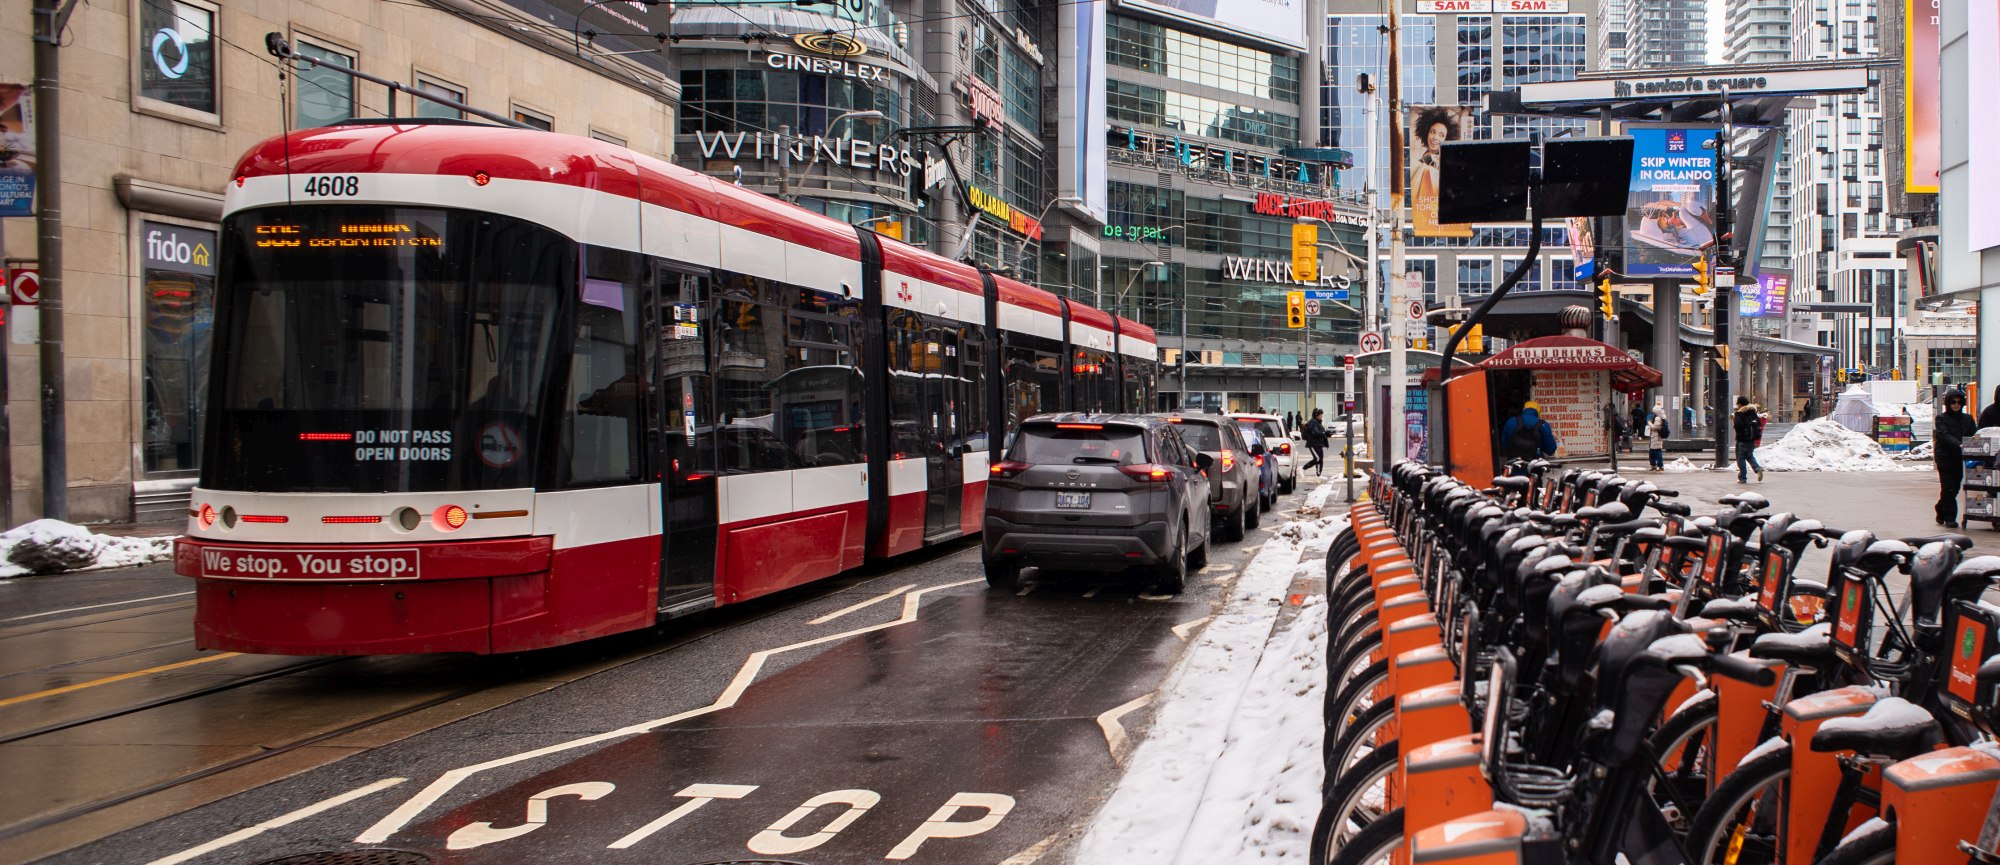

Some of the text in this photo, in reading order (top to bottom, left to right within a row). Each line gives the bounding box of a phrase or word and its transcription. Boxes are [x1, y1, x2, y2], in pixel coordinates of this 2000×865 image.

[1435, 1, 1470, 10] SAM
[1511, 1, 1546, 10] SAM
[767, 54, 882, 82] CINEPLEX
[1635, 76, 1767, 93] sankofa square
[1245, 120, 1267, 135] DMZ
[696, 130, 911, 177] WINNERS
[1641, 157, 1711, 168] SKIP WINTER
[1640, 170, 1712, 180] IN ORLANDO
[304, 175, 359, 196] 4608
[970, 185, 1010, 222] DOLLARAMA
[1254, 192, 1284, 216] JACK
[1288, 197, 1334, 222] ASTOR'S
[1105, 225, 1166, 241] be great.
[147, 231, 190, 264] fido
[1315, 291, 1334, 299] Yonge
[1495, 356, 1626, 366] HOT DOGS SAUSAGES
[1552, 349, 1602, 358] DRINKS
[356, 430, 451, 443] DO NOT PASS
[356, 447, 451, 461] OPEN DOORS
[205, 551, 414, 579] We stop. You stop.
[446, 782, 1015, 859] STOP
